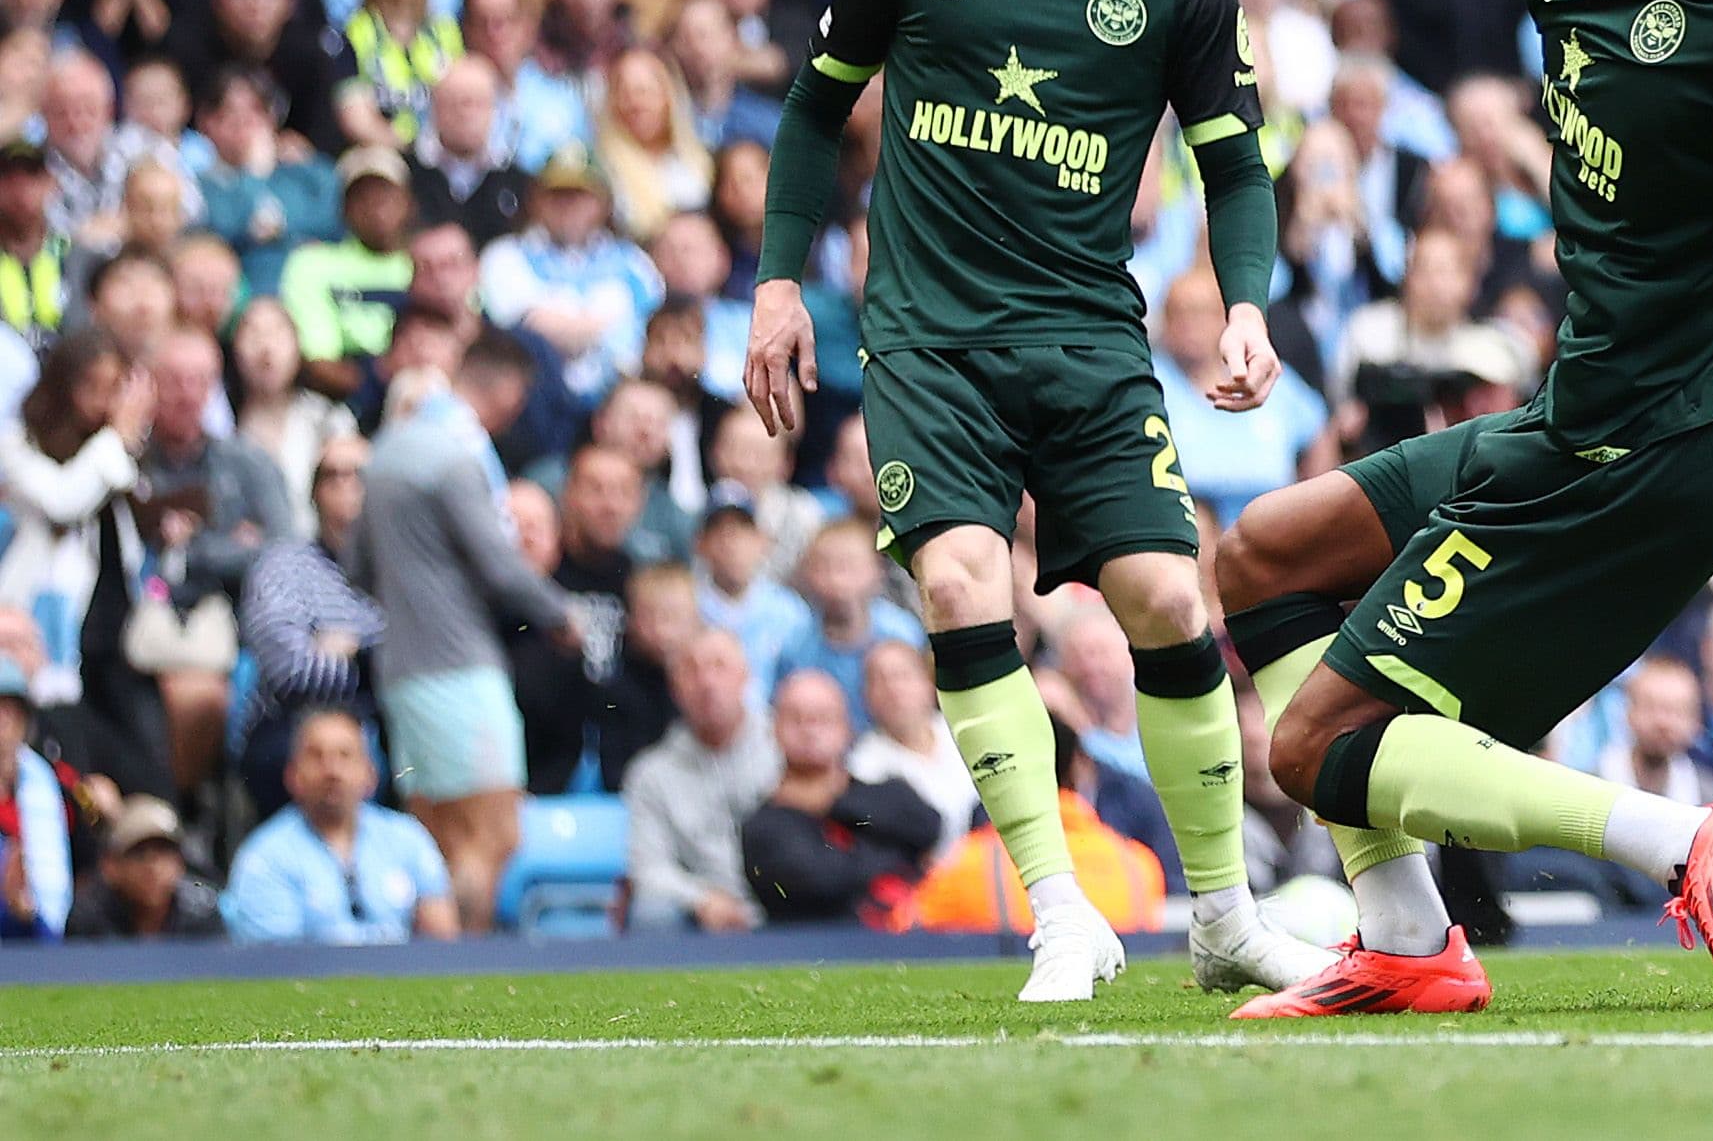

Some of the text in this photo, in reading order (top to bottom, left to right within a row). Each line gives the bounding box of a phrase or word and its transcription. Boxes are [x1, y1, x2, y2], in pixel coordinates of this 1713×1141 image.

[909, 100, 1108, 174] HOLLYWOOD
[1057, 163, 1101, 195] bets
[1578, 159, 1616, 203] bets
[1144, 414, 1189, 495] 2
[1404, 529, 1493, 618] 5
[1376, 618, 1407, 646] umbro
